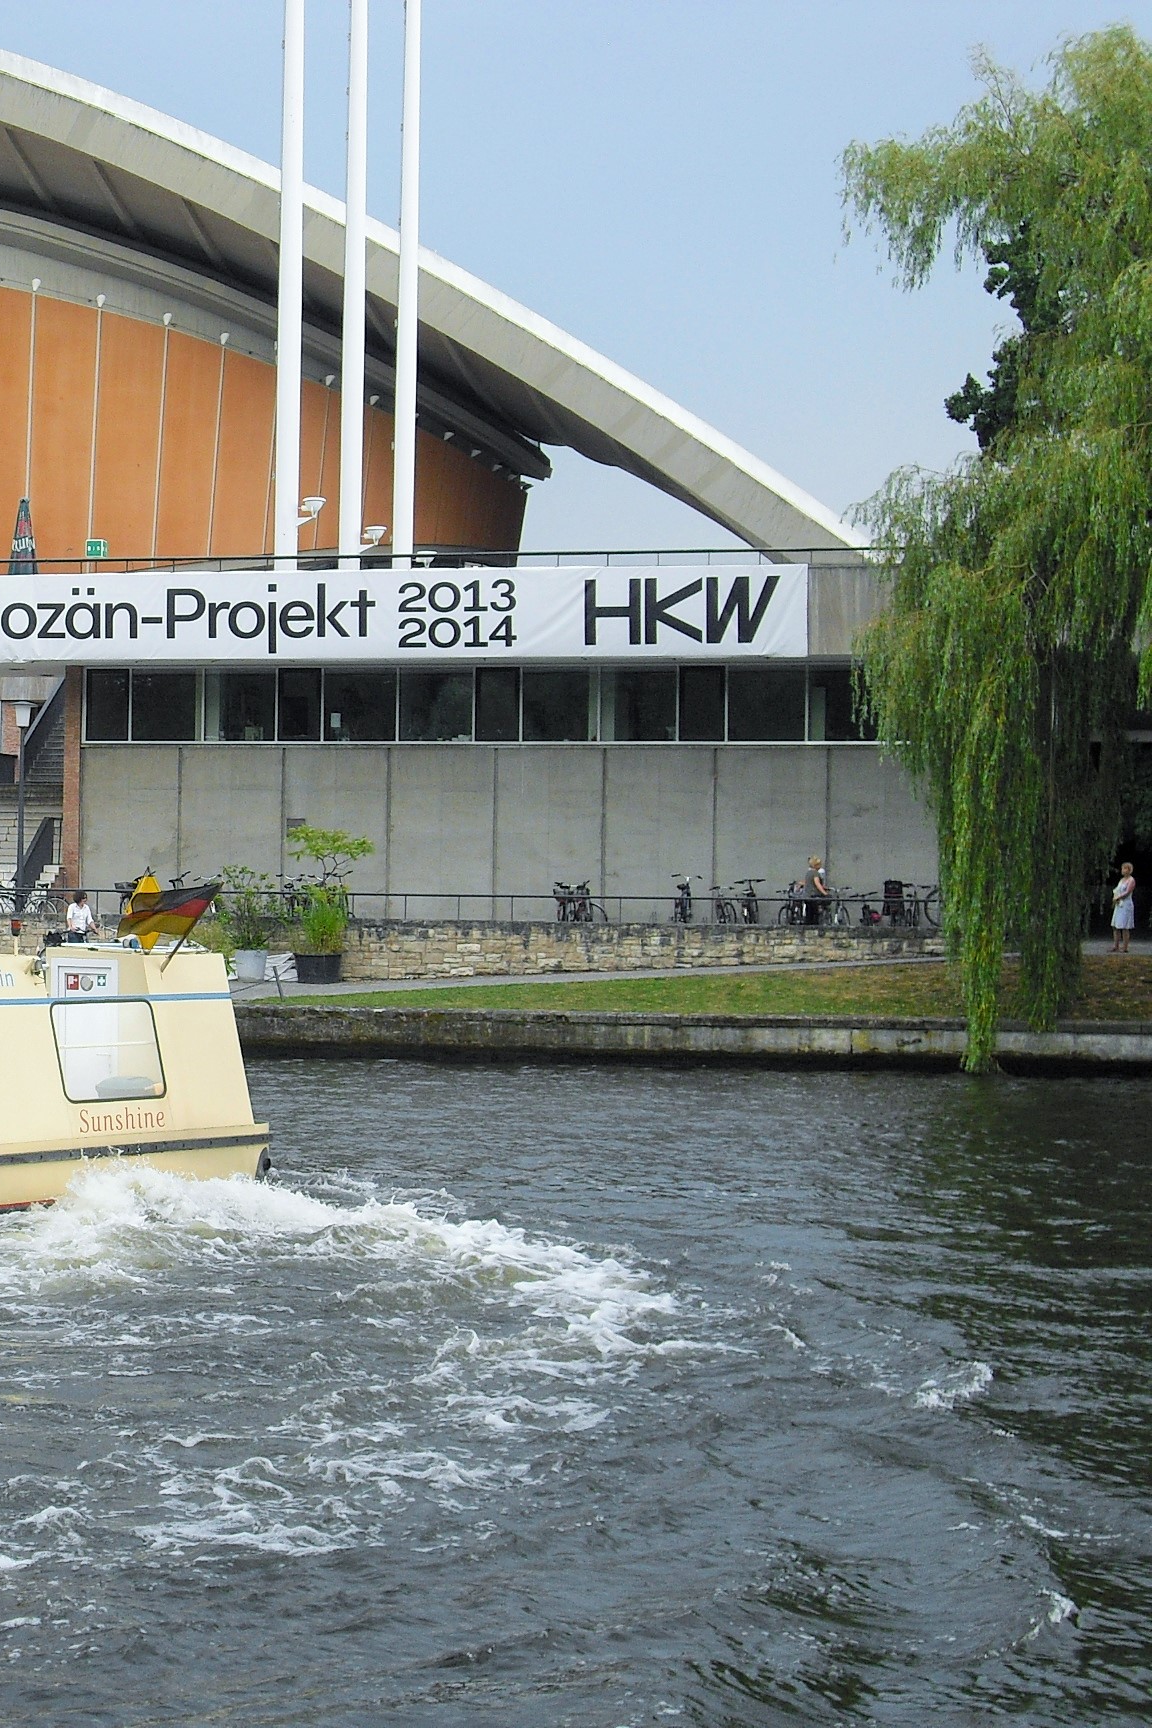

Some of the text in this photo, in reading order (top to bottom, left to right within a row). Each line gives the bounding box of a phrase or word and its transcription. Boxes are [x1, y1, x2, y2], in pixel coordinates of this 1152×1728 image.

[398, 579, 517, 613] 2013
[584, 575, 781, 645] HKW
[398, 615, 517, 649] 2014
[79, 1106, 166, 1134] Sunshine
